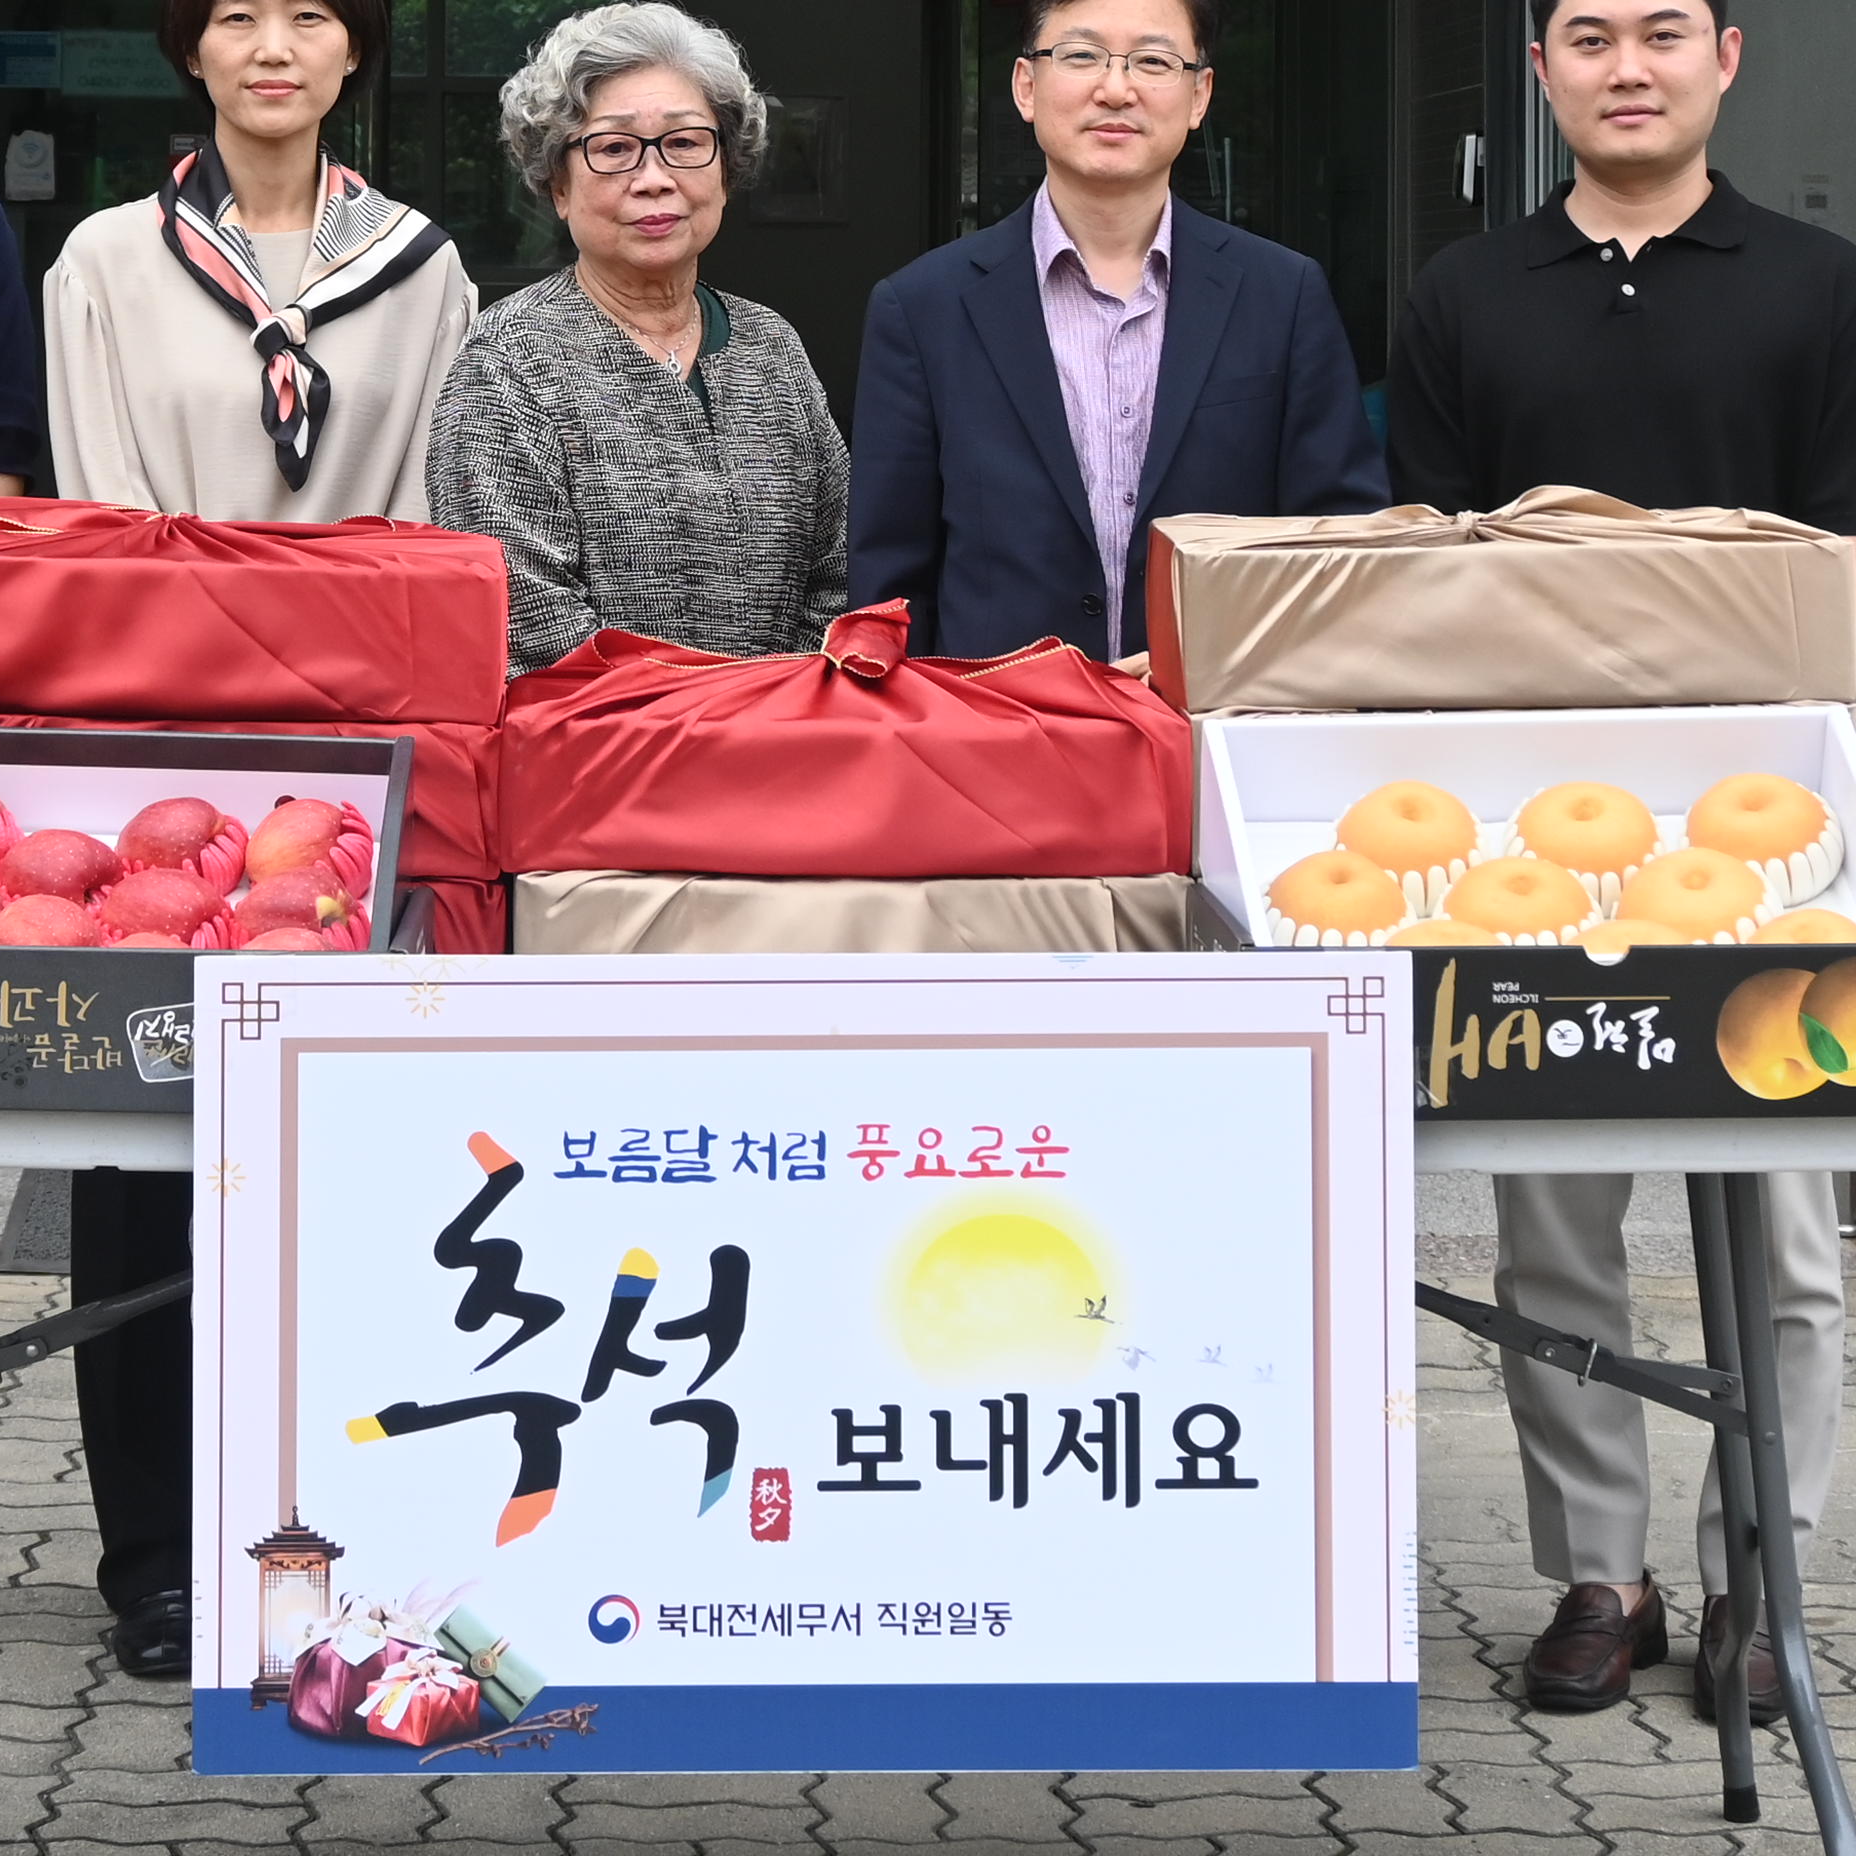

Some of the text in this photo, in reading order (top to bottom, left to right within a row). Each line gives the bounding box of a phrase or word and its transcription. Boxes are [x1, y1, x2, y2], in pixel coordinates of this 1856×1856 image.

[1492, 981, 1520, 992] PEAR
[1492, 993, 1539, 1004] ILCHEON
[134, 1011, 194, 1044] 랭지
[1430, 958, 1542, 1109] 배
[25, 1032, 123, 1074] 반달곰
[846, 1123, 1070, 1182] 풍요로운
[344, 1131, 1258, 1547] 추석 보내세요
[754, 1477, 787, 1532] 秋夕
[656, 1600, 1014, 1639] 북대전세무서 직원일동
